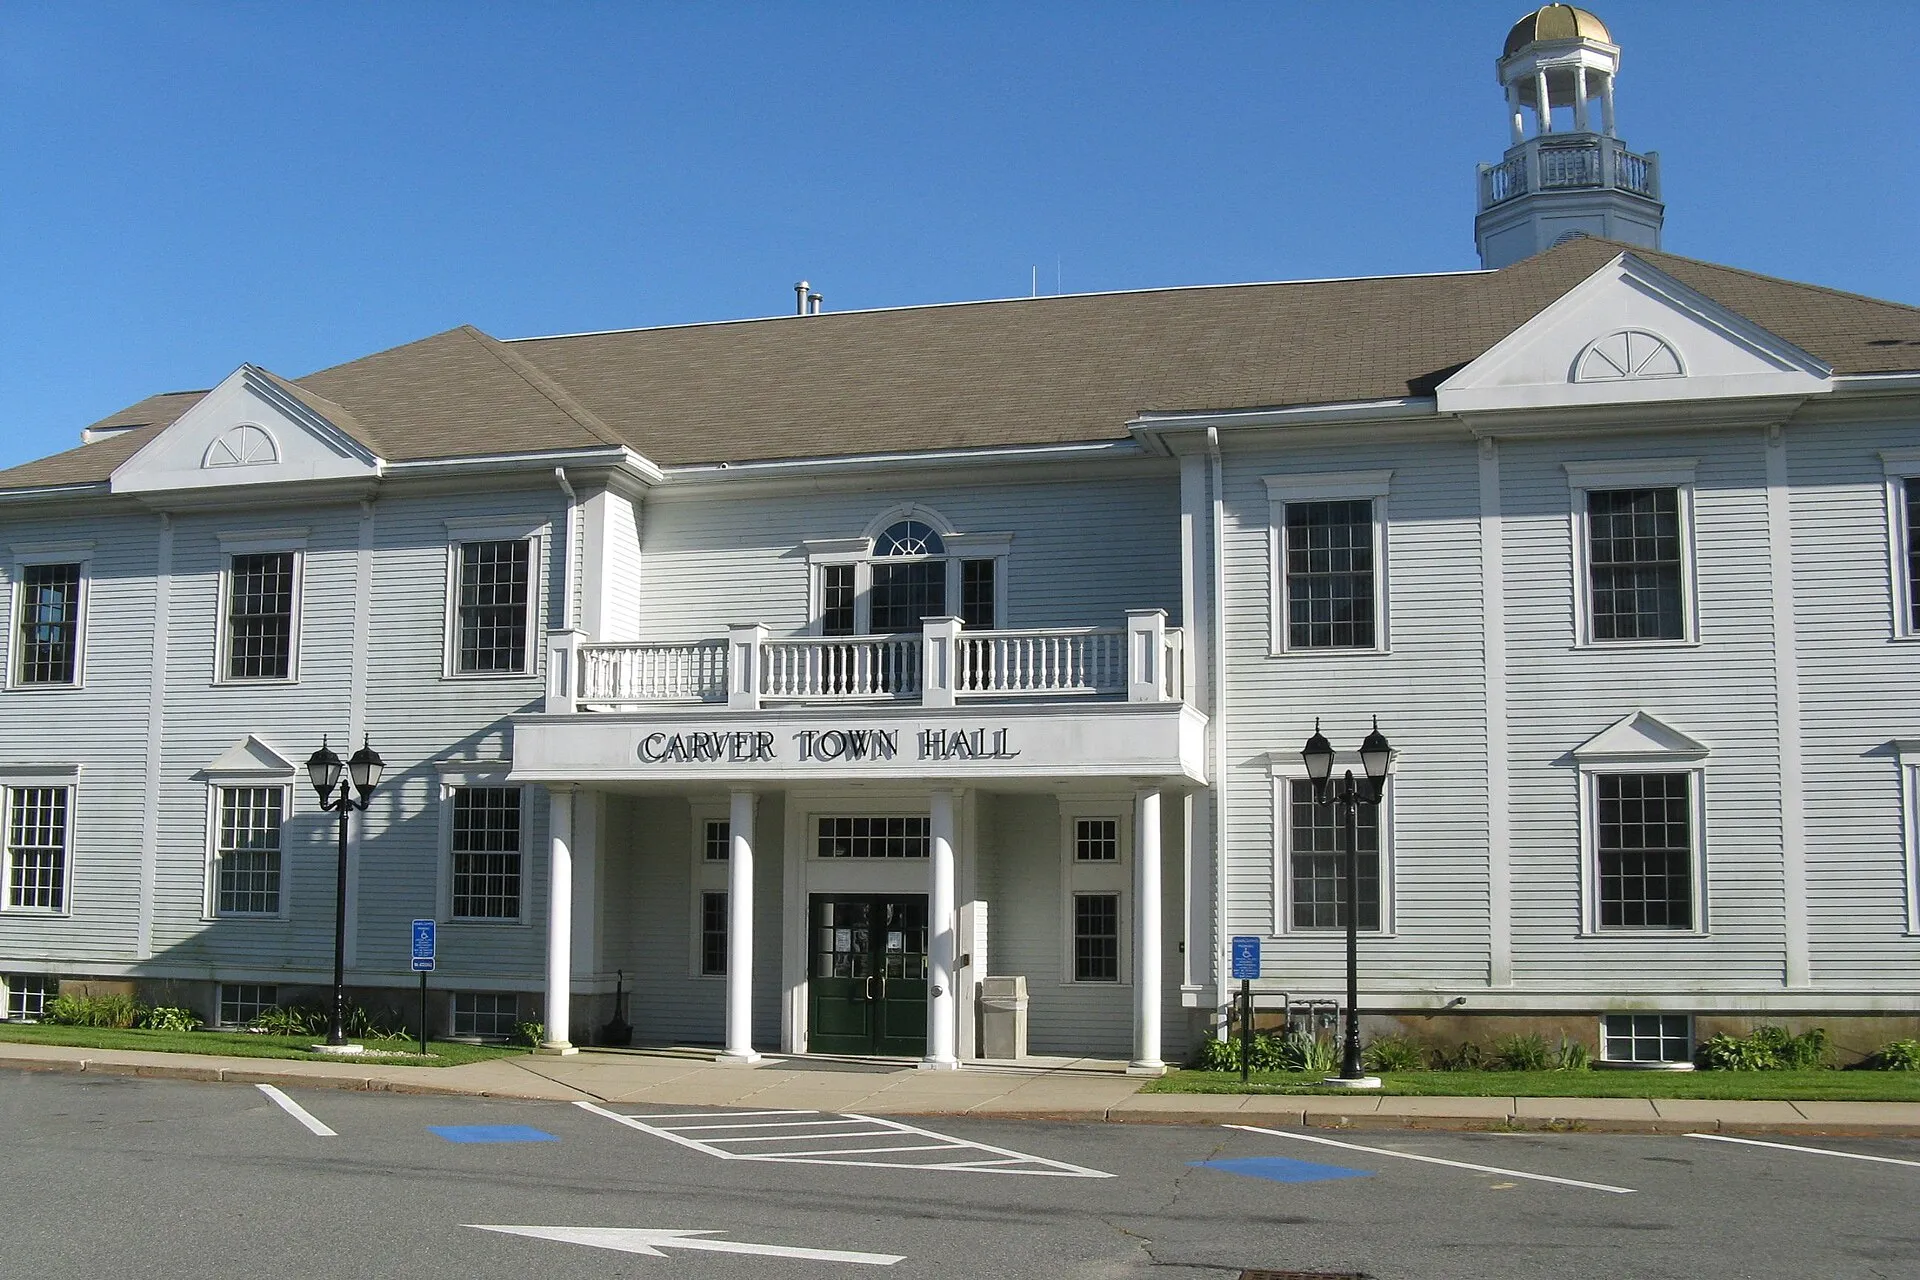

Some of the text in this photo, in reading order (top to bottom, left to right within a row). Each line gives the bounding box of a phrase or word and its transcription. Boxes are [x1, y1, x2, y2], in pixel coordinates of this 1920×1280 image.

[640, 727, 1021, 762] CARVER TOWN HALL
